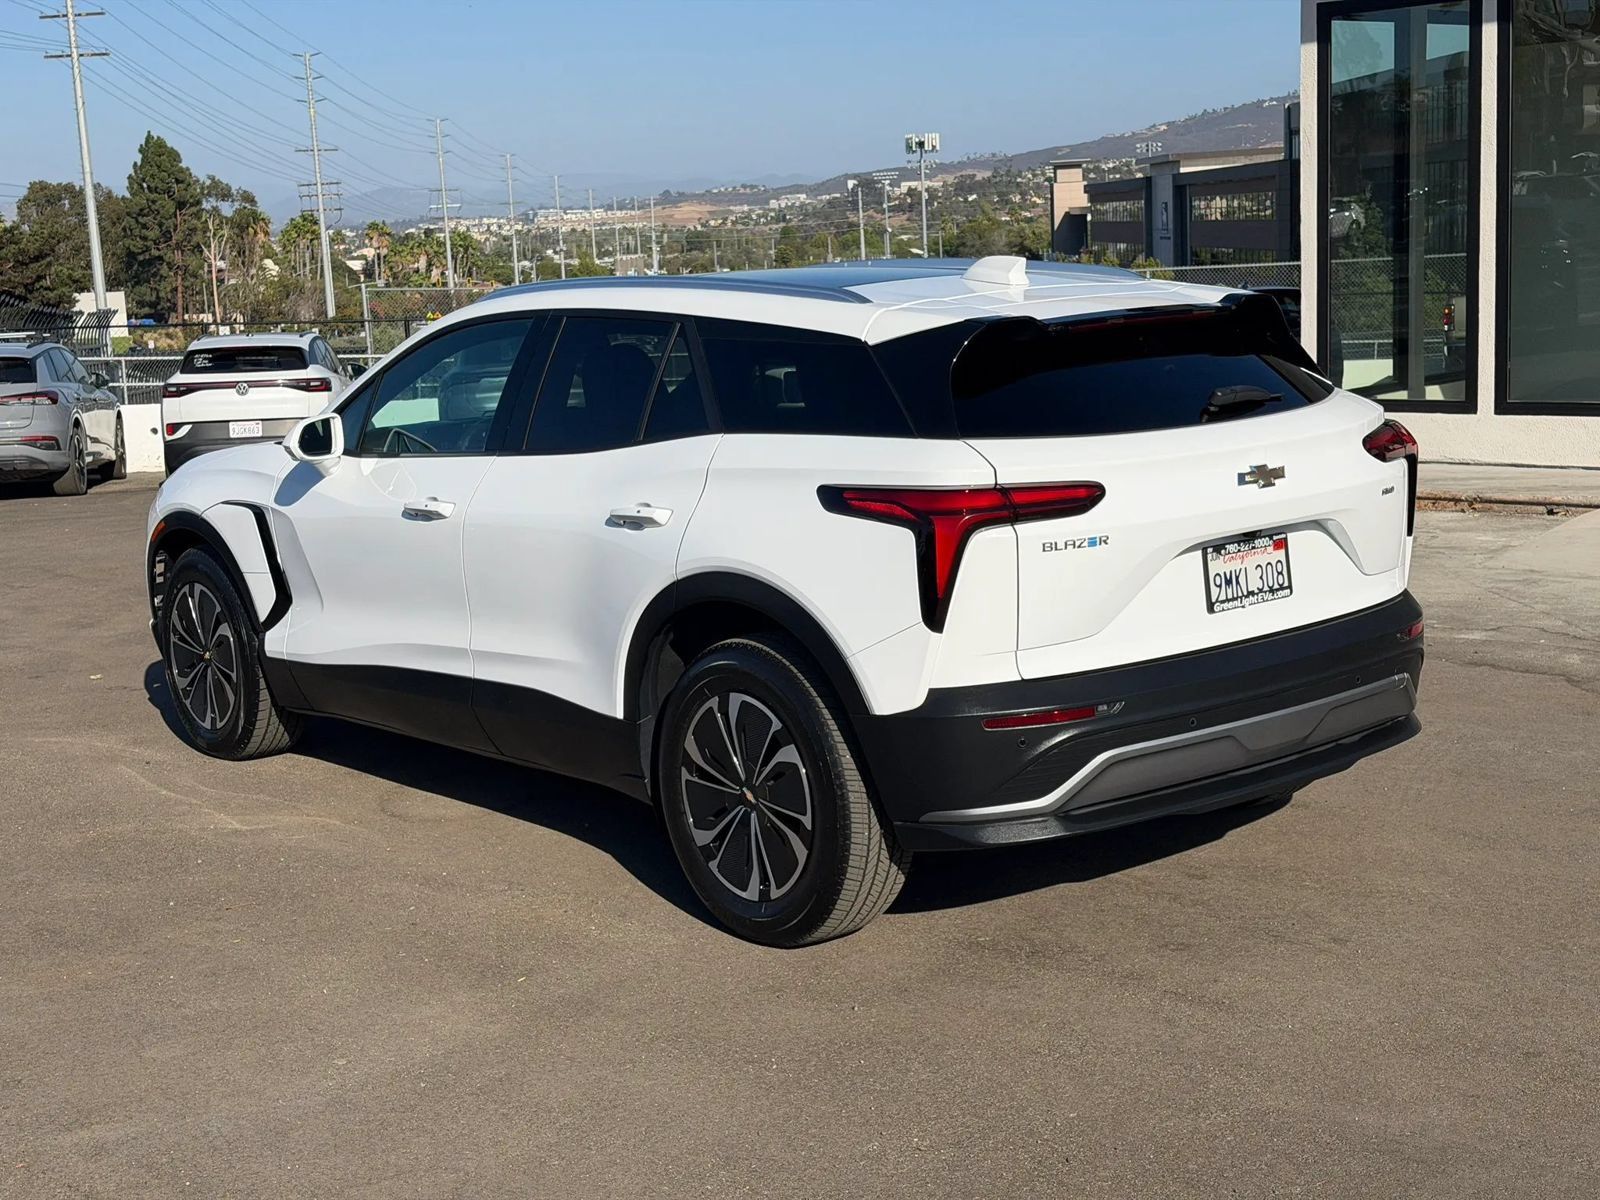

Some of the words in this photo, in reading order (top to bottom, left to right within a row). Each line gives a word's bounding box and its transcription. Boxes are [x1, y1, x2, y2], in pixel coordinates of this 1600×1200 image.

[1042, 535, 1110, 552] BLAZER
[1213, 559, 1286, 603] 9MKL308
[1213, 588, 1291, 612] GreenLightEVs.com
